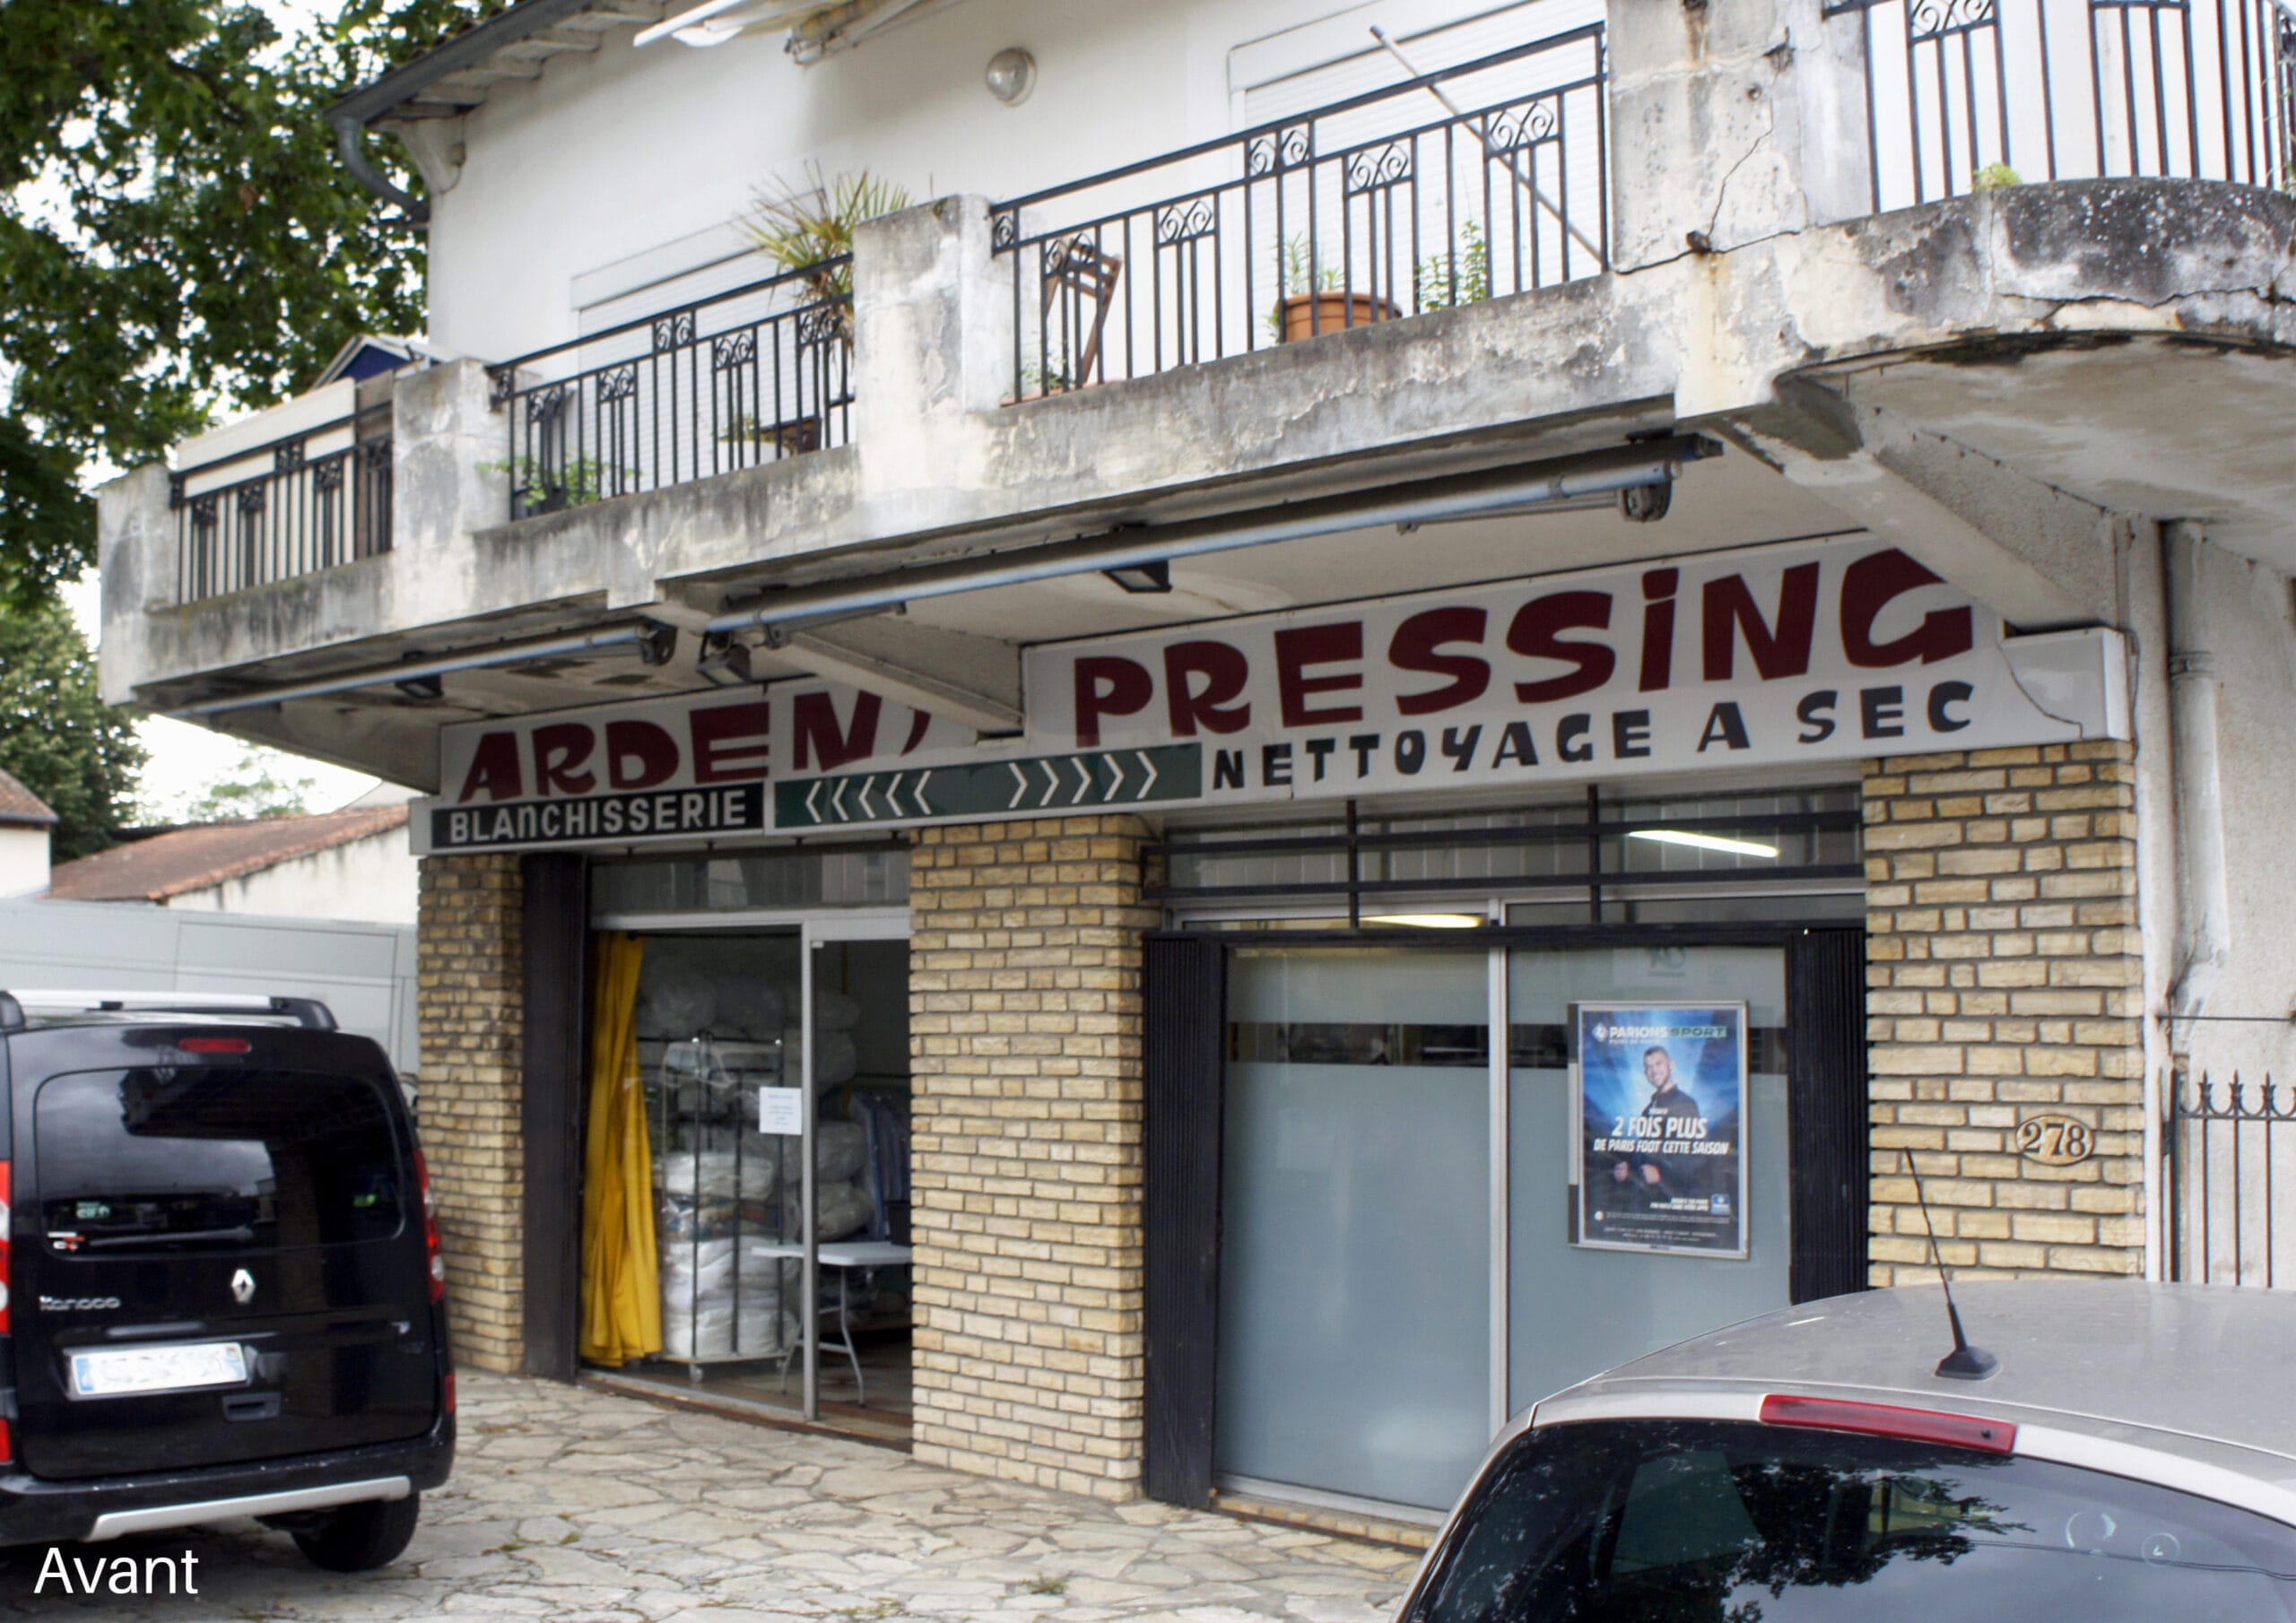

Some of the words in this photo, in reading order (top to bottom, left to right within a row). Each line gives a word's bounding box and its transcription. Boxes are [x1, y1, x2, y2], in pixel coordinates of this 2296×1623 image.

[1074, 547, 1973, 748] PRESSING
[1213, 713, 1650, 792] NETTOYAGE
[1698, 702, 1751, 750] A
[1796, 681, 1975, 744] SEC
[449, 789, 746, 844] BLANCHISSERIE
[1609, 1026, 1667, 1038] PARIONS
[1668, 1026, 1727, 1038] SPORT
[1612, 1116, 1624, 1137] 2
[1627, 1116, 1663, 1138] FOIS
[1665, 1117, 1708, 1139] PLUS
[2022, 1122, 2086, 1157] 278
[1593, 1138, 1608, 1151] DE
[1608, 1139, 1636, 1152] PARIS
[1636, 1140, 1662, 1153] FOOT
[1663, 1141, 1692, 1154] CETTE
[1692, 1141, 1729, 1155] SAISON
